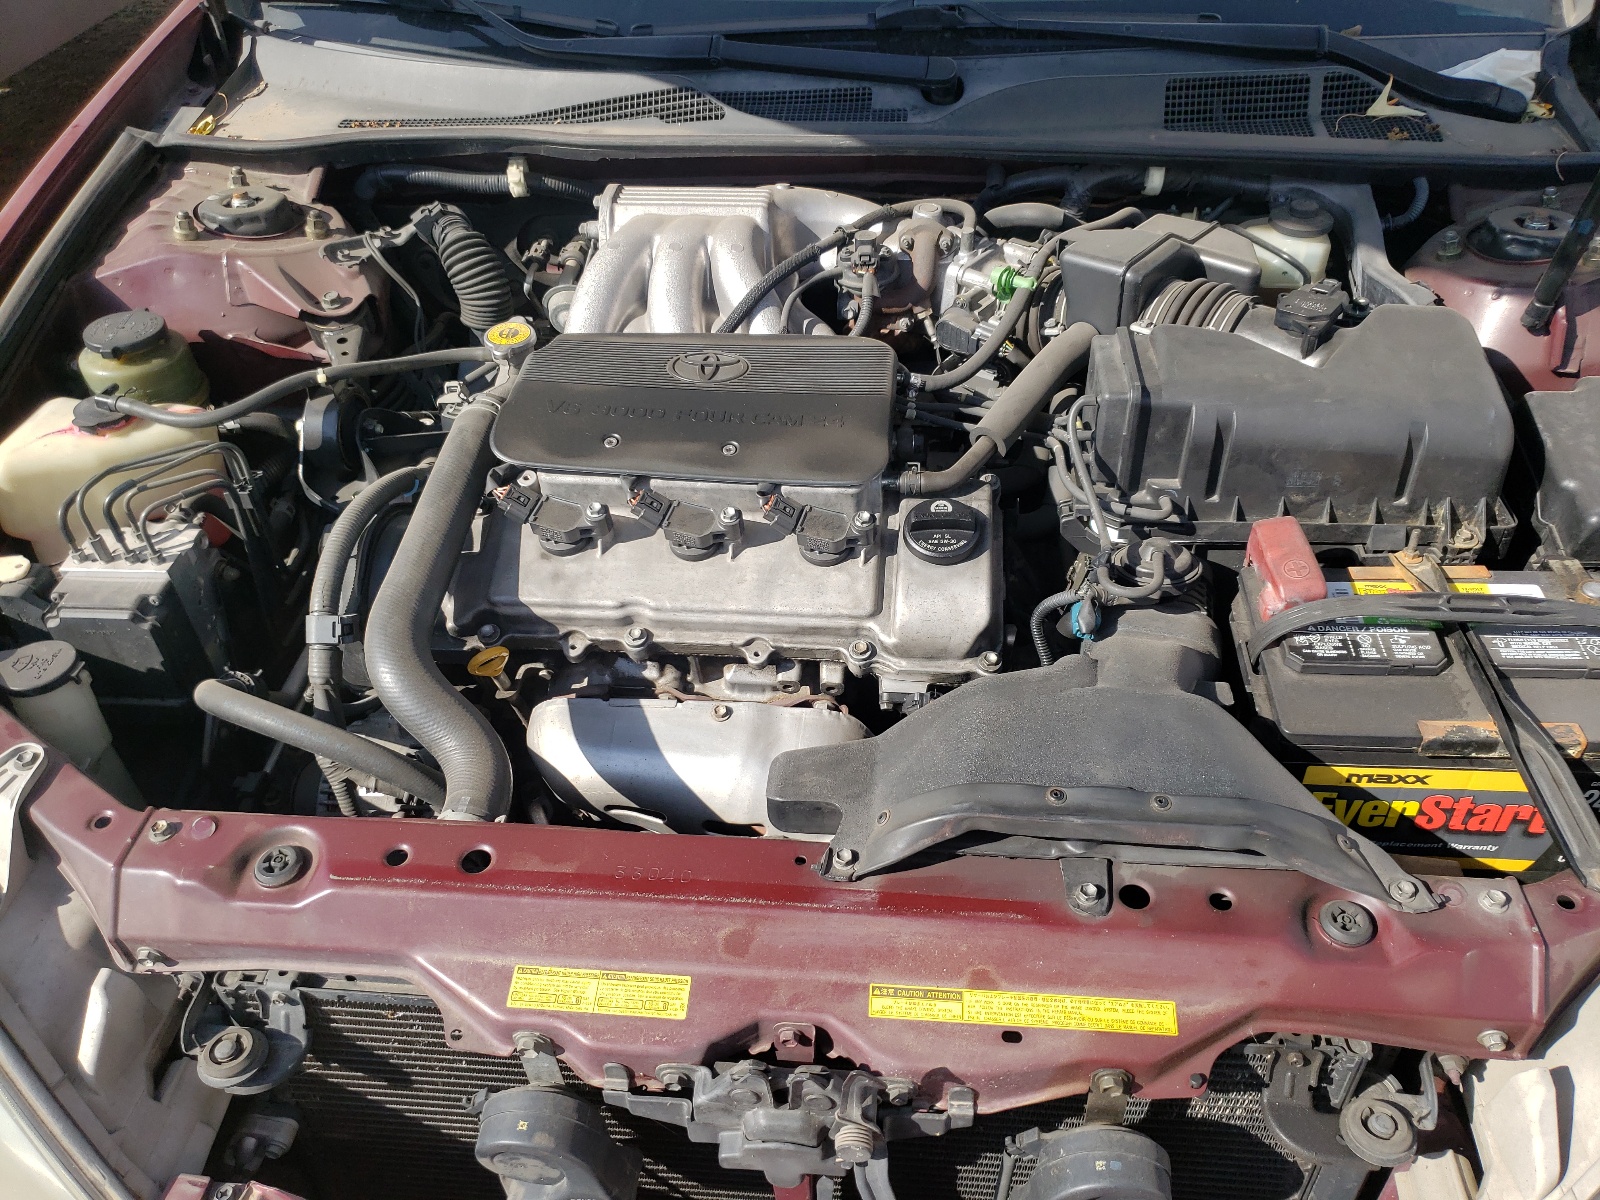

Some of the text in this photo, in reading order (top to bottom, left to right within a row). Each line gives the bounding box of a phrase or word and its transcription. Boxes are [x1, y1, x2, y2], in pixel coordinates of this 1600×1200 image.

[1346, 773, 1433, 786] maxx
[1446, 842, 1500, 852] Warranty
[897, 989, 924, 998] CAUTION
[926, 990, 961, 1000] ATTENTION
